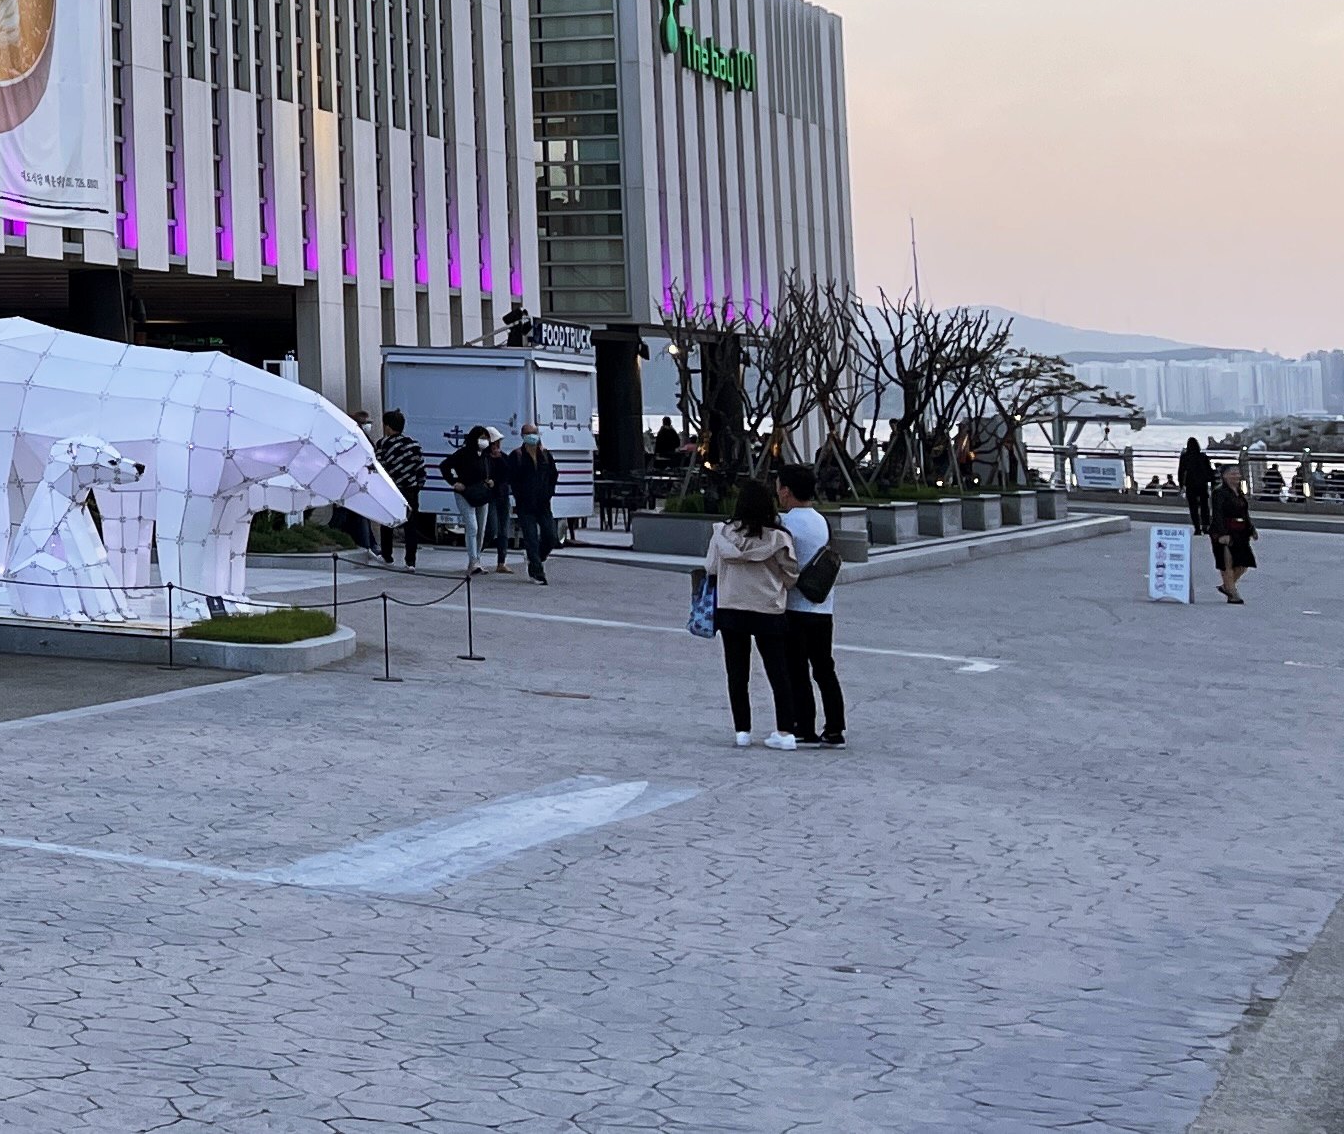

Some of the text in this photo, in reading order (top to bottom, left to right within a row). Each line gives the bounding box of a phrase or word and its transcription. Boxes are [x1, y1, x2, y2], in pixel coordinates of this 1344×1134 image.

[683, 27, 757, 92] The bay 101
